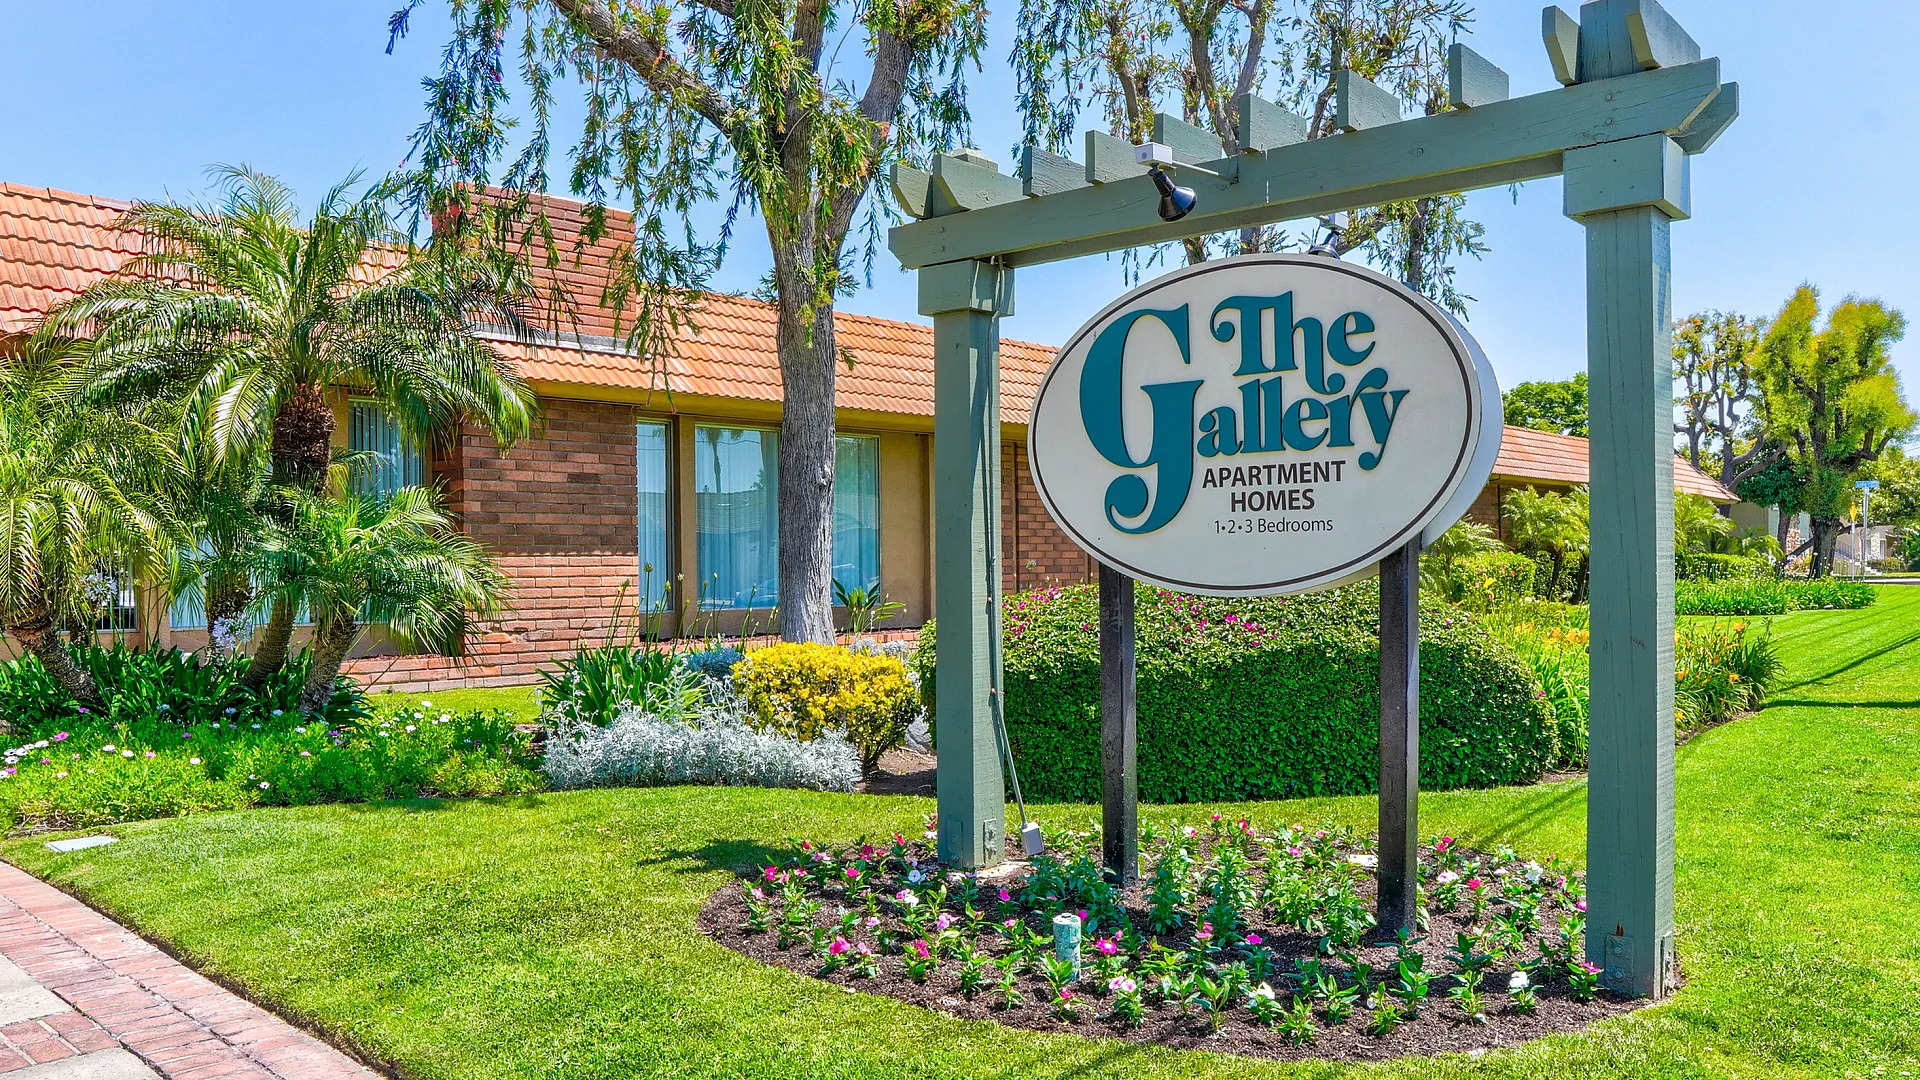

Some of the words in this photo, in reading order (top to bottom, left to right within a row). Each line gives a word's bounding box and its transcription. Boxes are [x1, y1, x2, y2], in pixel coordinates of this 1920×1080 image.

[1209, 290, 1376, 395] The
[1079, 303, 1410, 534] Gallery
[1202, 460, 1346, 488] APARTMENT
[1231, 488, 1315, 512] HOMES
[1258, 517, 1334, 533] Bedrooms
